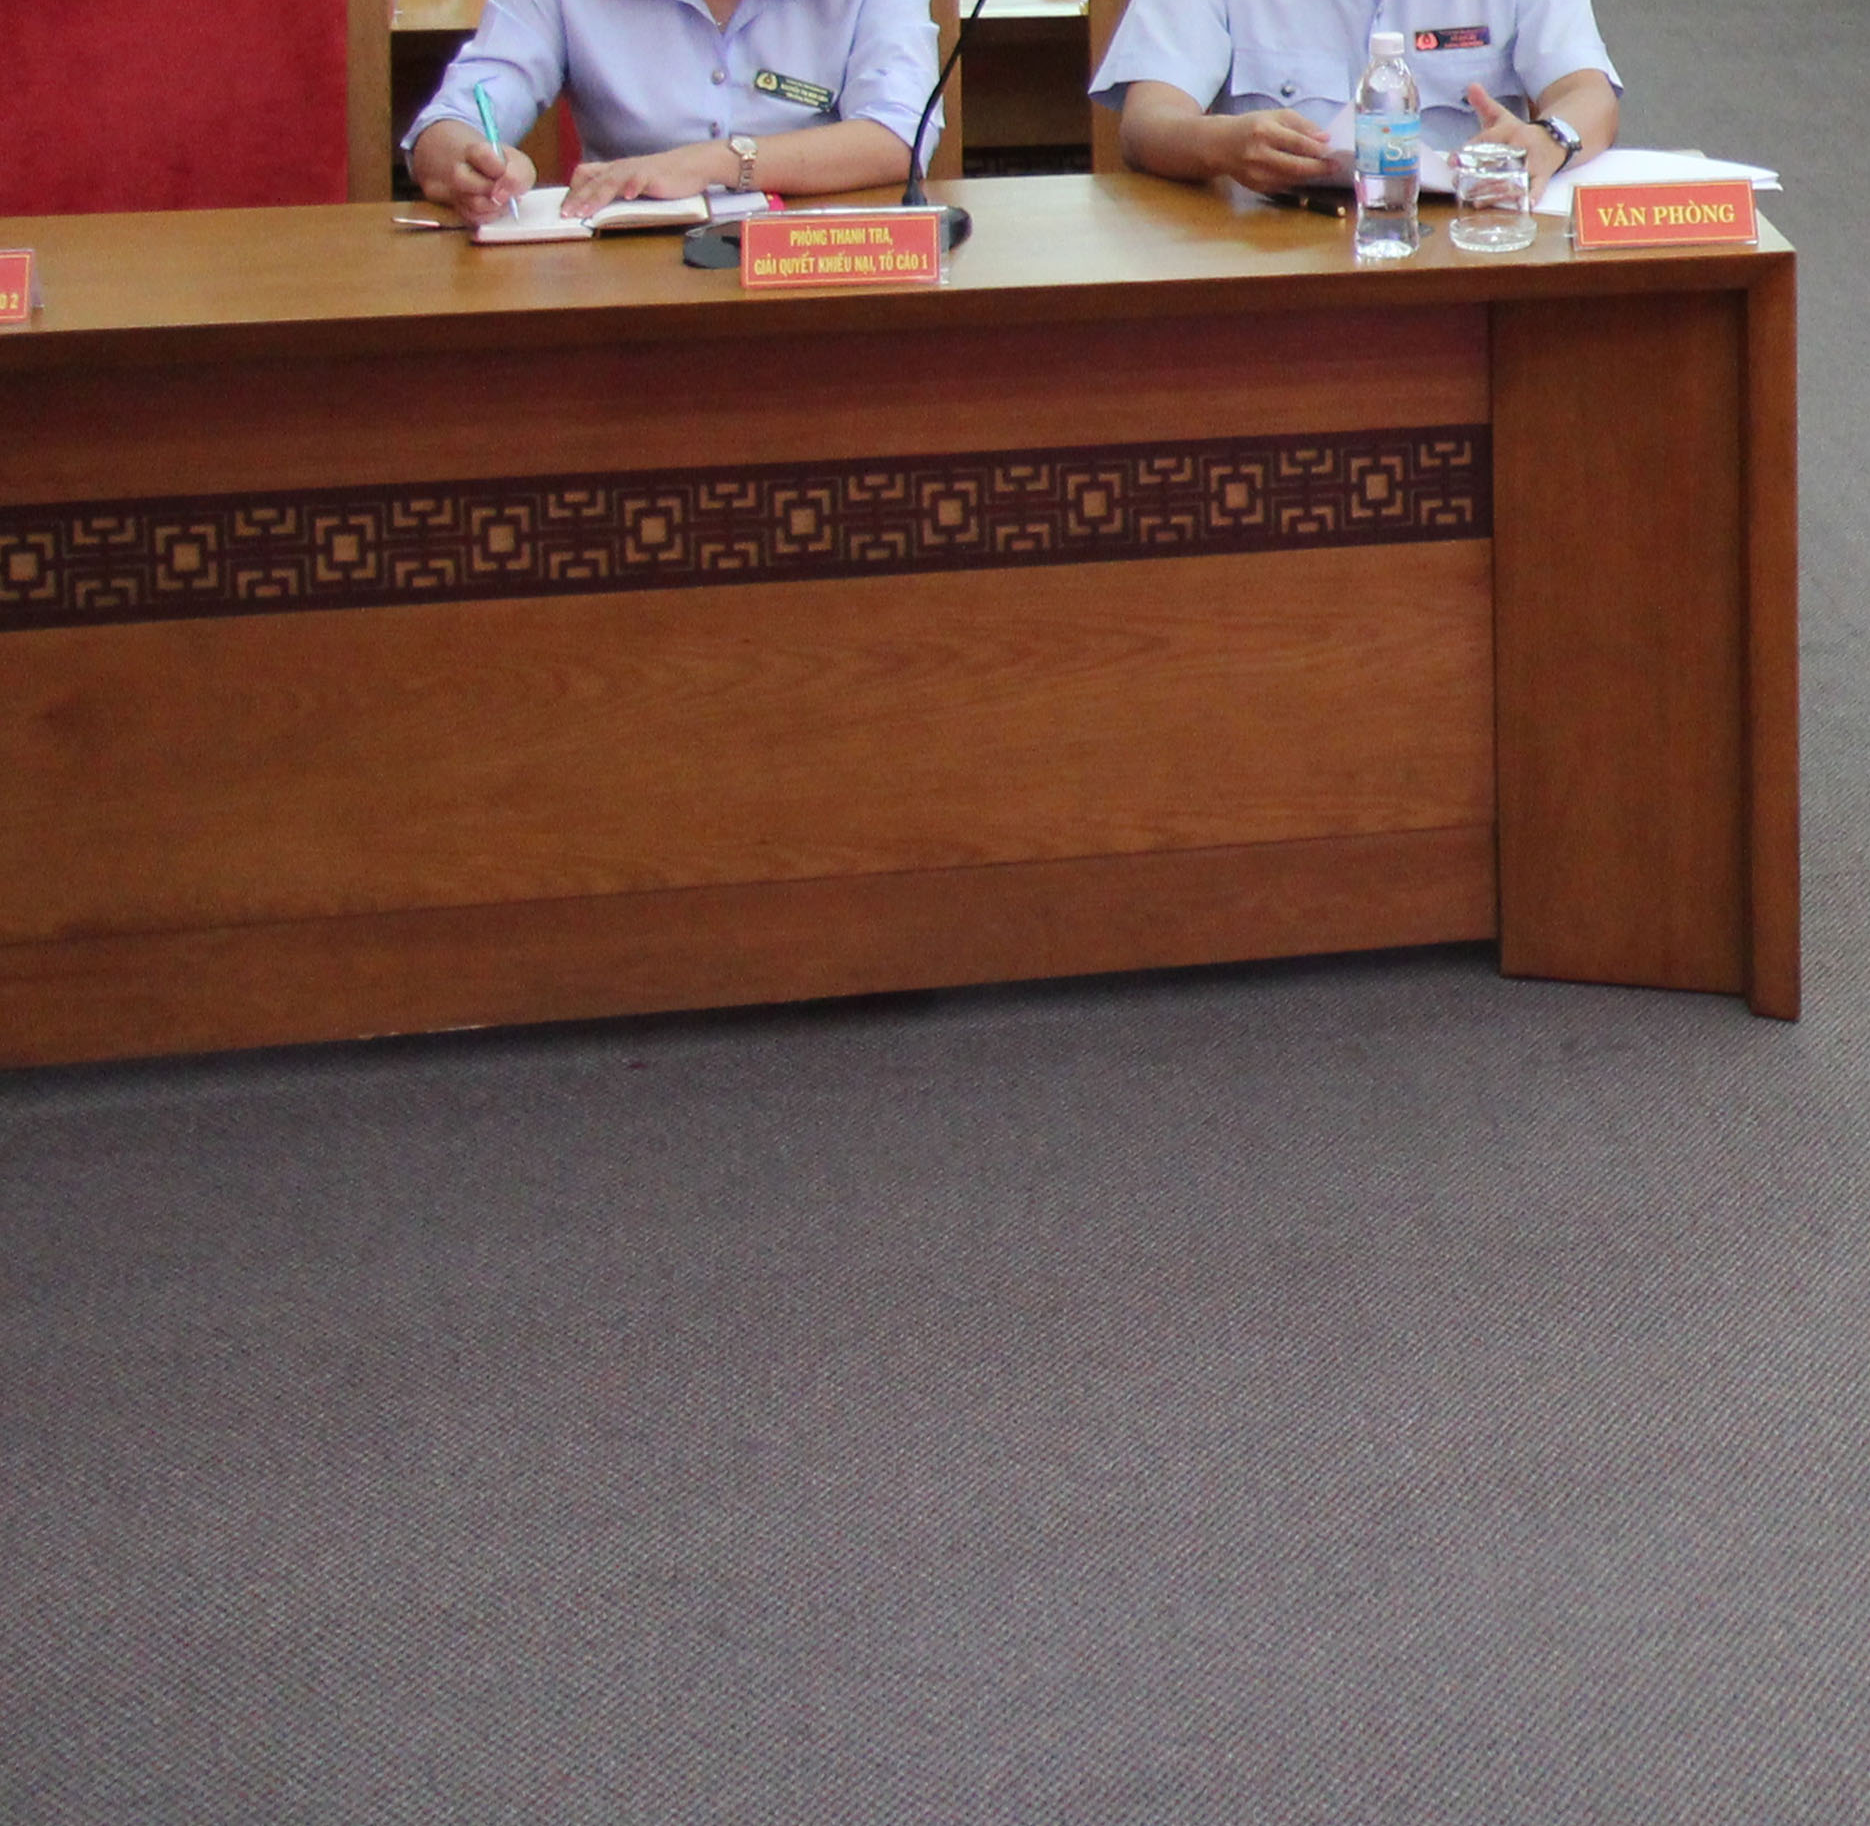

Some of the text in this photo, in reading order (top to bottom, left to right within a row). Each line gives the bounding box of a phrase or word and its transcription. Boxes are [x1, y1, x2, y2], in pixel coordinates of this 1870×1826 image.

[1597, 199, 1737, 228] VĂN PHÒNG
[789, 225, 894, 247] PHÒNG THANH TRA,
[754, 253, 777, 276] GIẢI
[779, 251, 815, 277] QUYẾT
[818, 250, 853, 274] KHIẾU
[879, 249, 896, 271] TỐ
[896, 253, 919, 270] CÁO
[921, 254, 928, 270] 1
